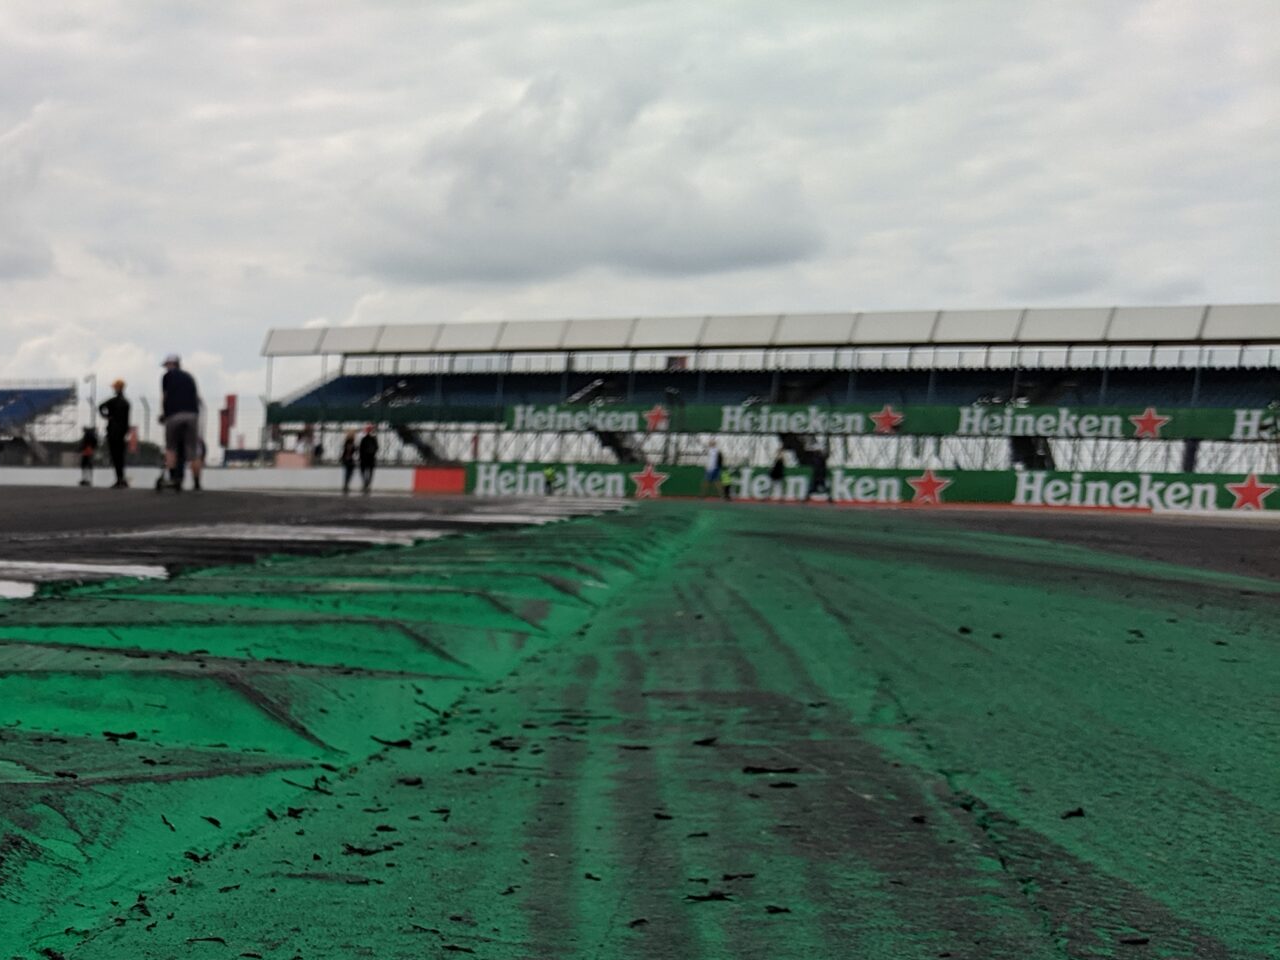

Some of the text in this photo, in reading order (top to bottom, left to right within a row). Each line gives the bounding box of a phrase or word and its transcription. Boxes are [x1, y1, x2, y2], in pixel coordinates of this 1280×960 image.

[513, 405, 638, 431] Heineken
[721, 405, 864, 433] Heineken
[957, 407, 1122, 438] Heineken
[1013, 471, 1218, 511] Heineken
